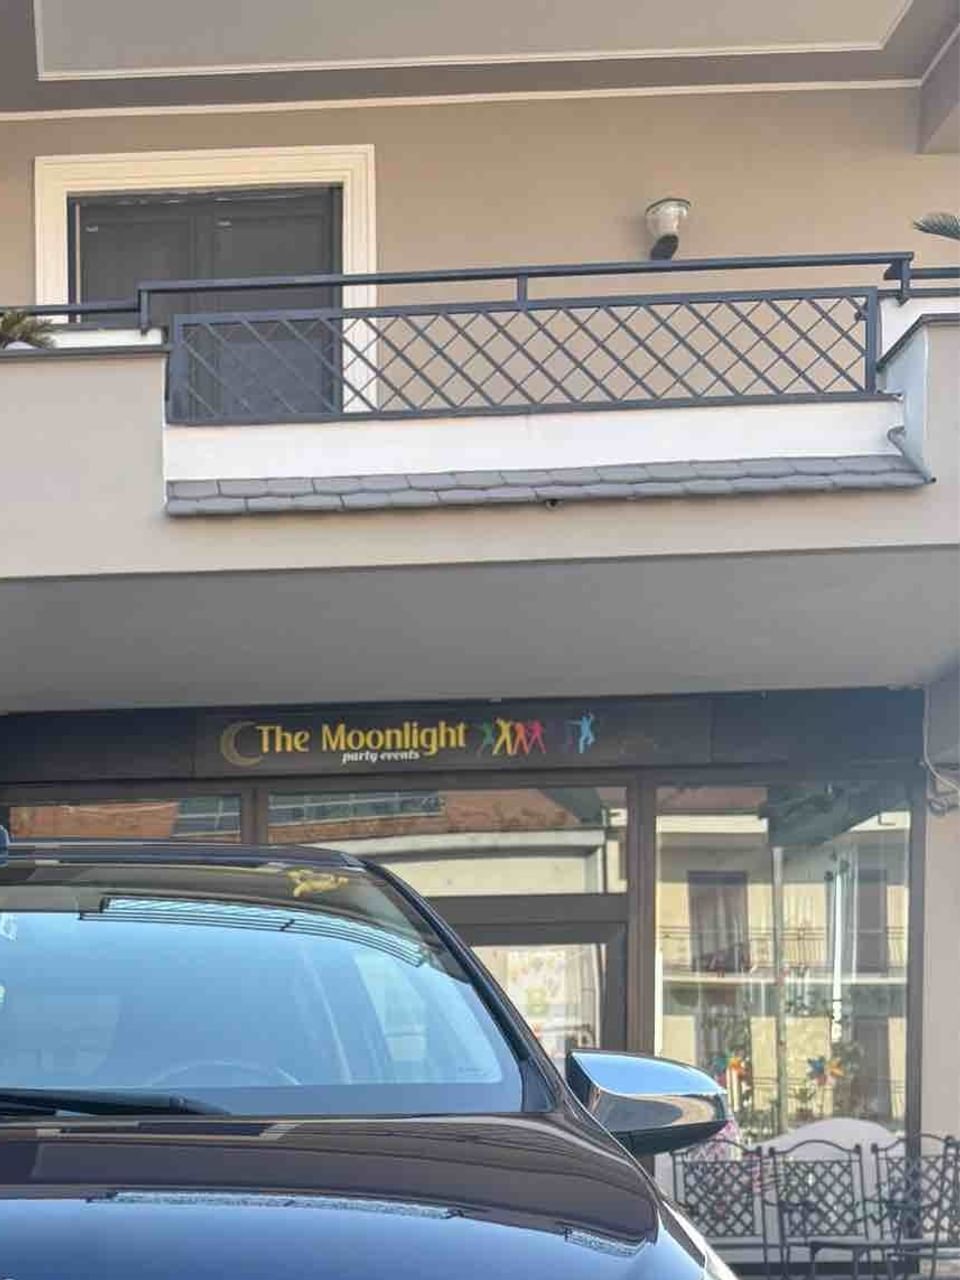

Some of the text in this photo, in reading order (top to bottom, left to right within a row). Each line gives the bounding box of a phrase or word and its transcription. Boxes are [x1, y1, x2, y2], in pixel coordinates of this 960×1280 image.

[257, 721, 466, 756] The Moonlight
[342, 750, 420, 764] party events
